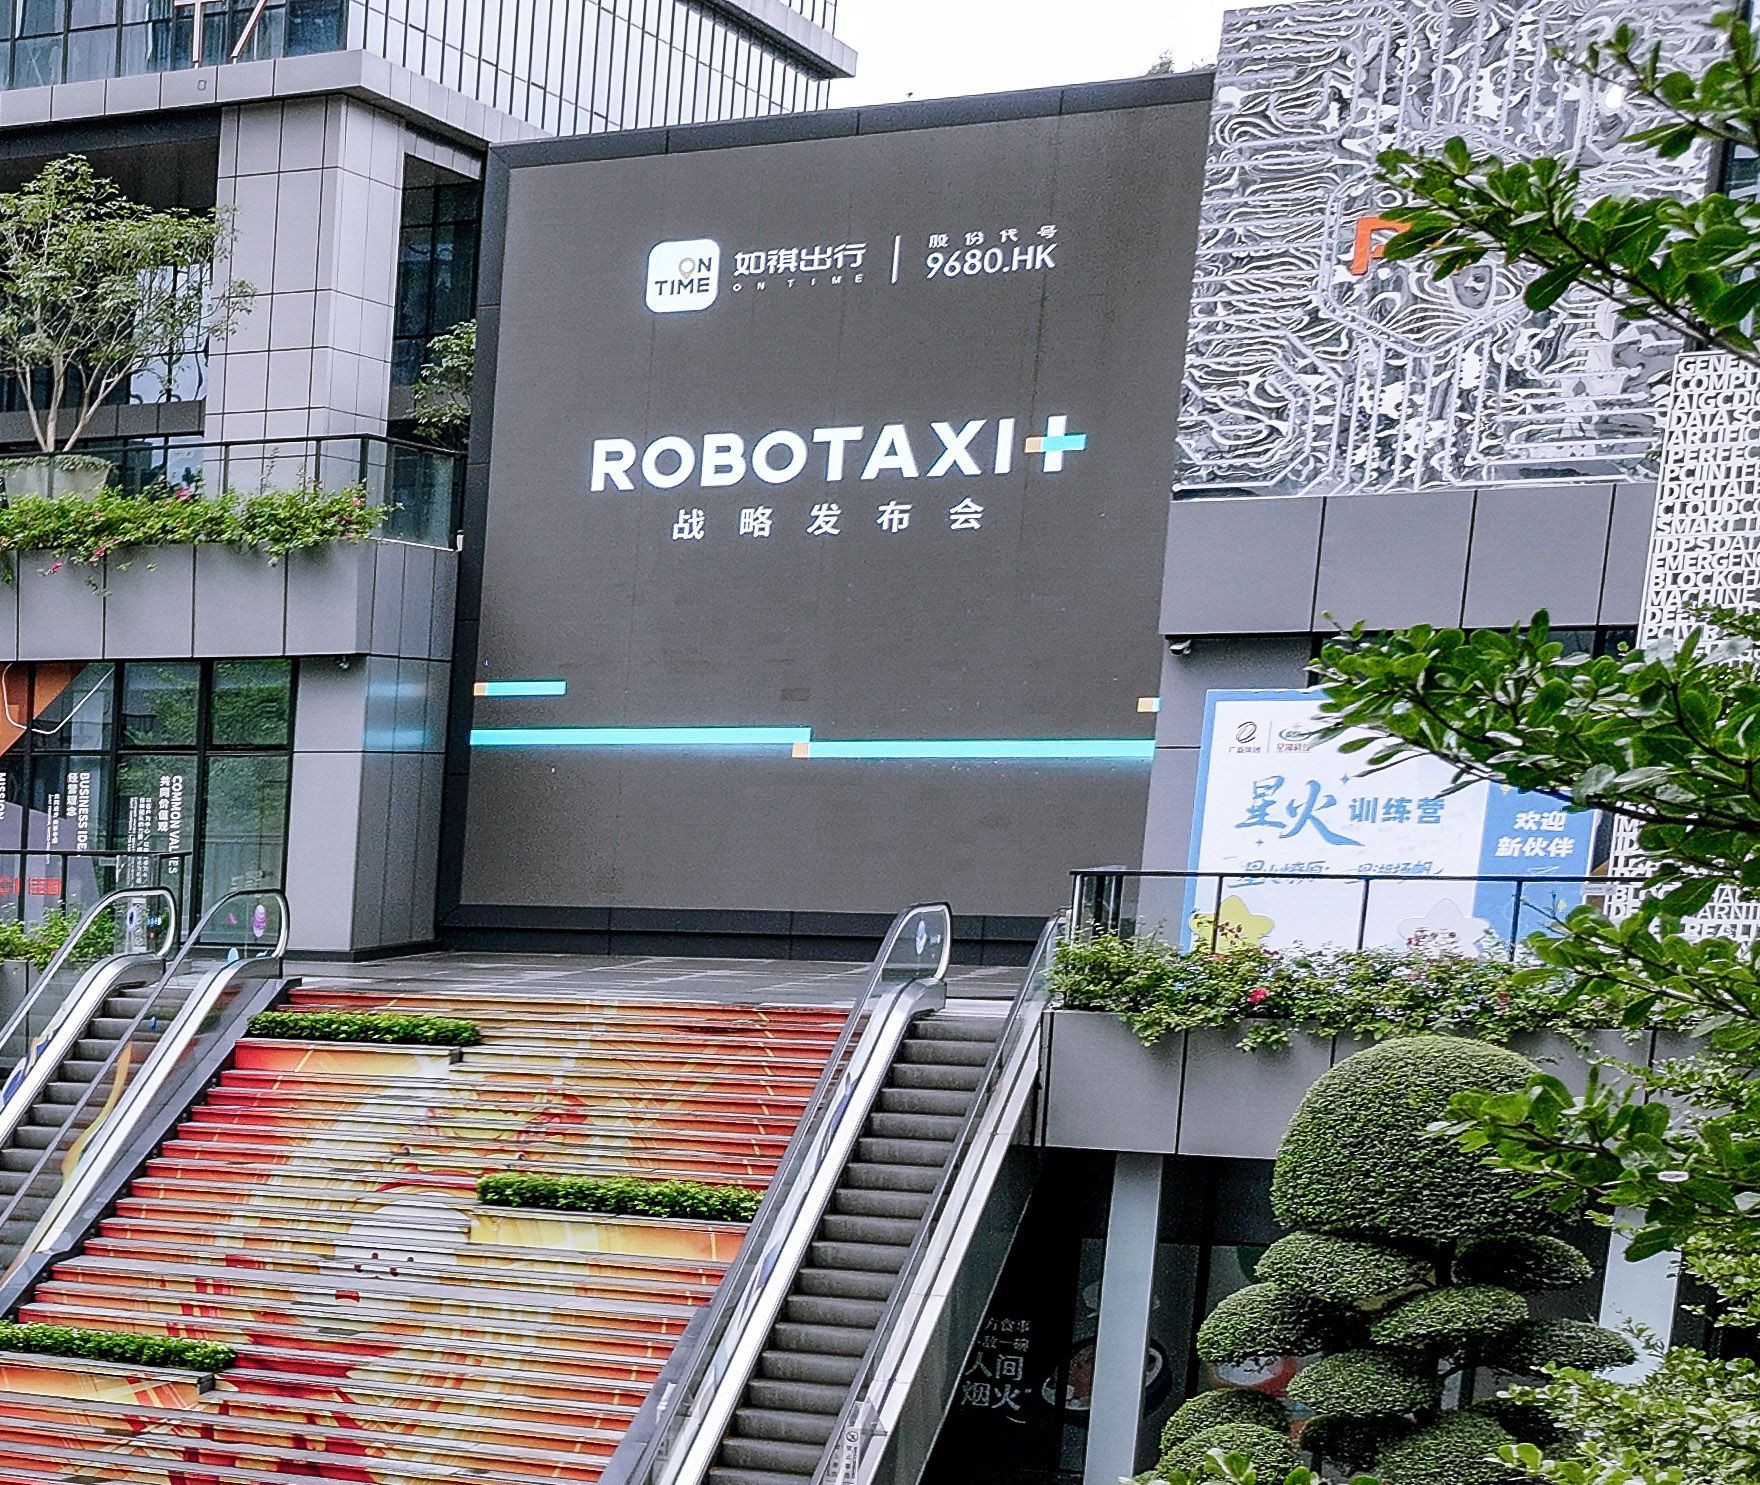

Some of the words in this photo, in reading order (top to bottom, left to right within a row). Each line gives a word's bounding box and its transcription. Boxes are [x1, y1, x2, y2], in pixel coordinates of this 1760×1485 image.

[927, 224, 1058, 248] 股份代号
[678, 256, 713, 280] ON
[732, 242, 868, 276] 如祺出行
[925, 242, 1057, 280] 9680.HK
[653, 275, 711, 298] TIME
[1670, 409, 1732, 428] DATA
[671, 496, 985, 541] 战略发布会
[1659, 498, 1736, 518] CLOUD
[1655, 515, 1737, 536] SMART
[1654, 536, 1711, 555] IDPS
[1648, 587, 1755, 608] MACHINE
[78, 772, 90, 829] BUSINESS
[170, 775, 184, 831] COMMON
[1235, 775, 1365, 847] 星火
[1348, 797, 1445, 825] 训练营
[1513, 810, 1567, 832] 欢迎
[76, 830, 88, 858] IDE
[167, 832, 181, 874] VALES
[1495, 835, 1576, 858] 新伙伴
[977, 1335, 1029, 1352] 敌一碗
[964, 1351, 1024, 1381] 人间
